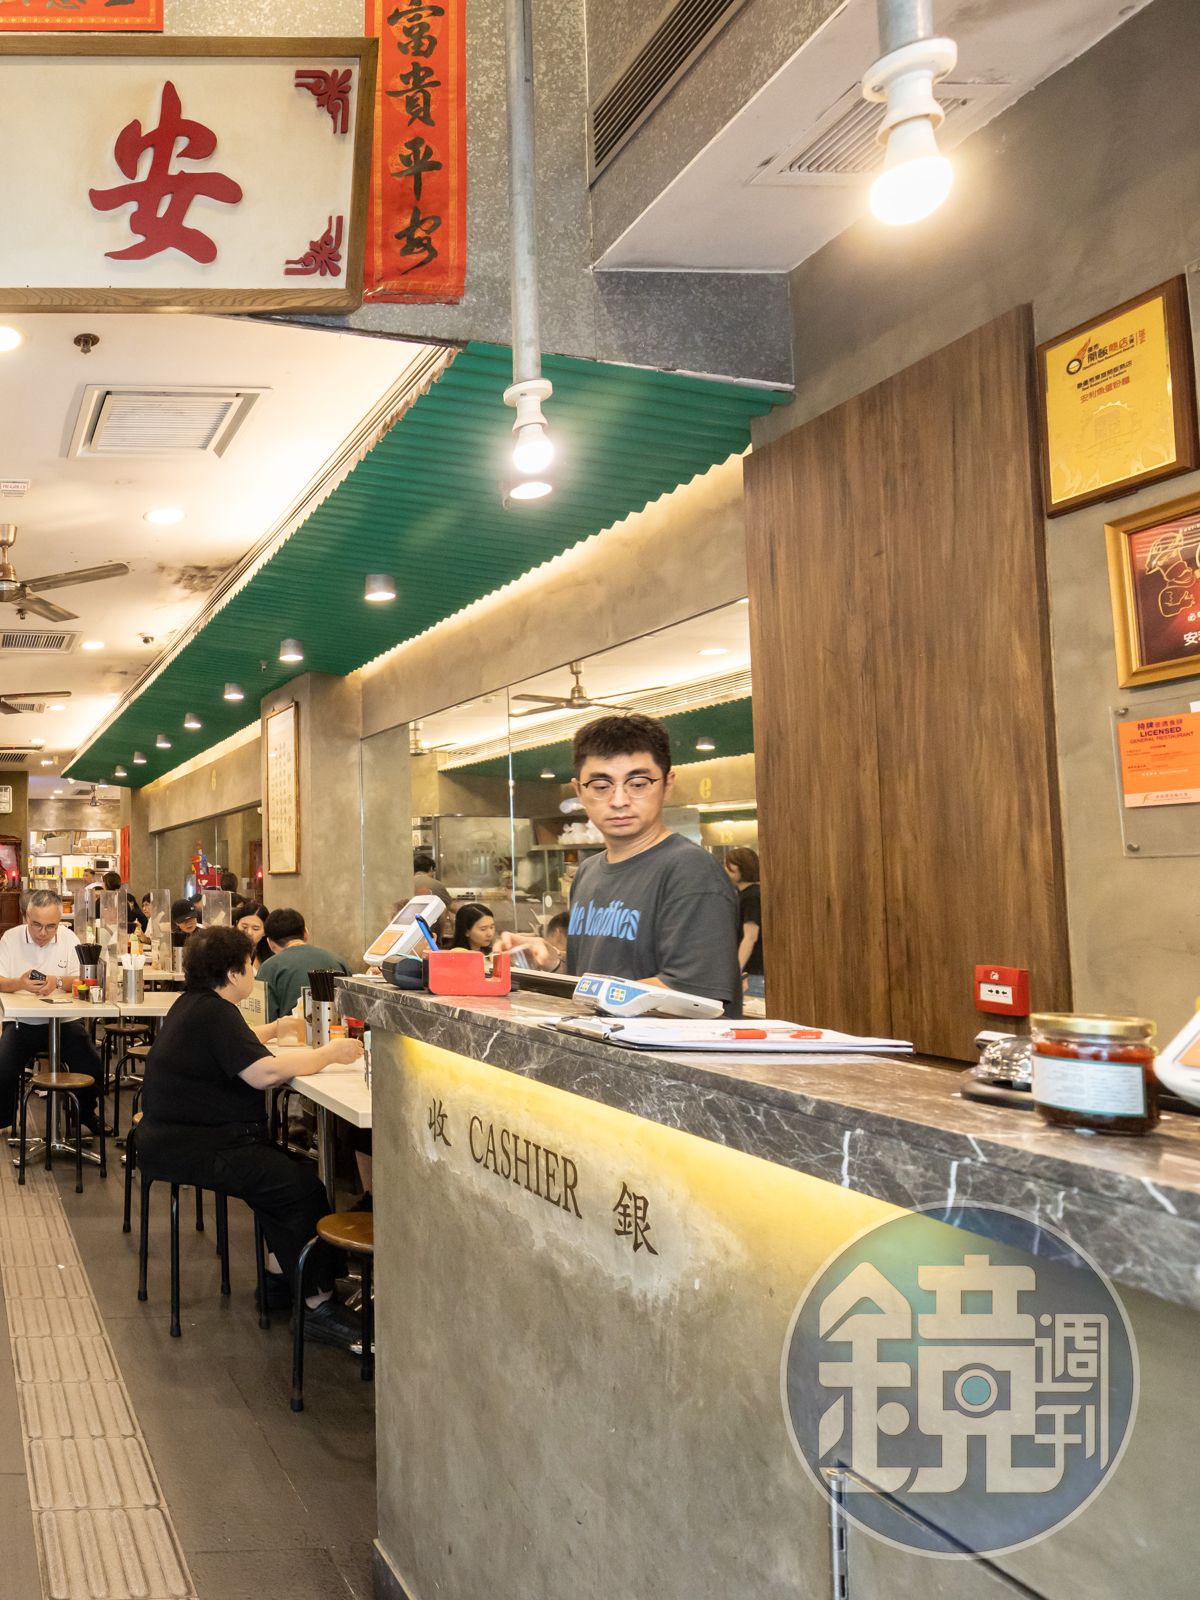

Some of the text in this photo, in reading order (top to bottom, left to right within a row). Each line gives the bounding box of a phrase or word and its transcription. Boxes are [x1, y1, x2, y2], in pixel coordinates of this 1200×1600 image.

[1140, 726, 1181, 737] LICENSED
[429, 1097, 659, 1256] 收 CASHIER 銀
